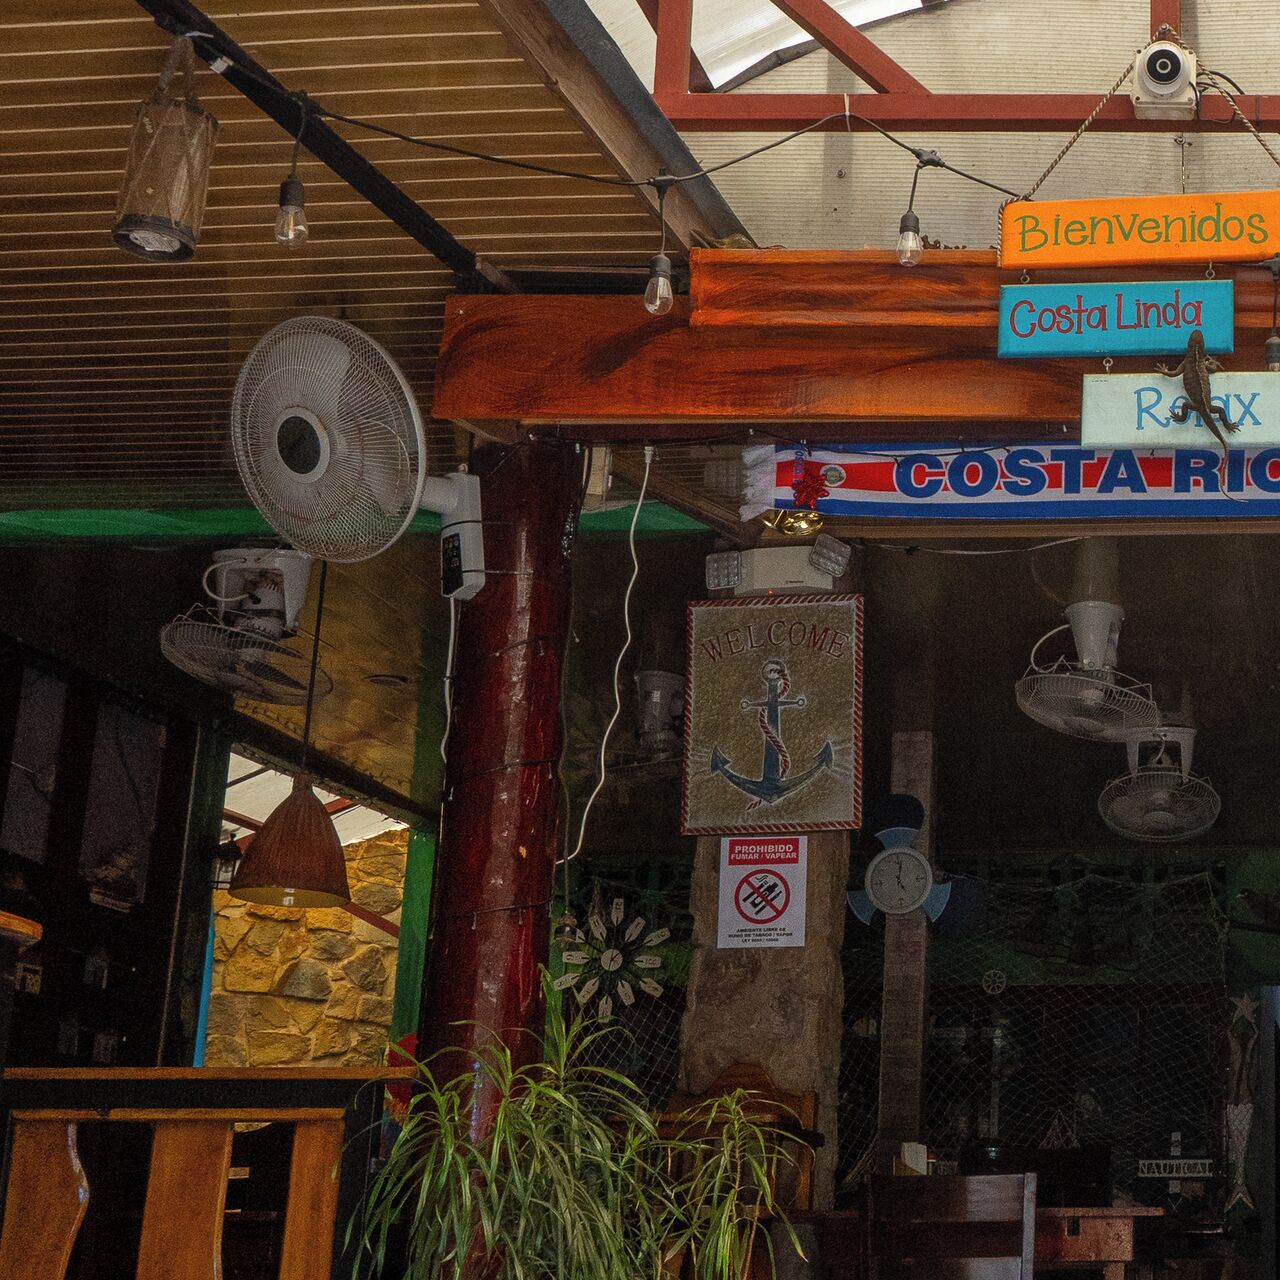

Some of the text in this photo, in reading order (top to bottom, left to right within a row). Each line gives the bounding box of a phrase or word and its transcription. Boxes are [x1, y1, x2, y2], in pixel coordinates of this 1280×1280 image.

[1014, 203, 1269, 252] Bienvenidos
[1009, 290, 1204, 338] Costa Linda
[896, 449, 1148, 498] COSTA
[700, 620, 850, 663] WELCOME
[730, 852, 759, 860] FUMAR
[765, 851, 797, 860] VAPEAR
[734, 844, 794, 853] PROHIBIDO
[1138, 1159, 1213, 1177] NAUTICAL
